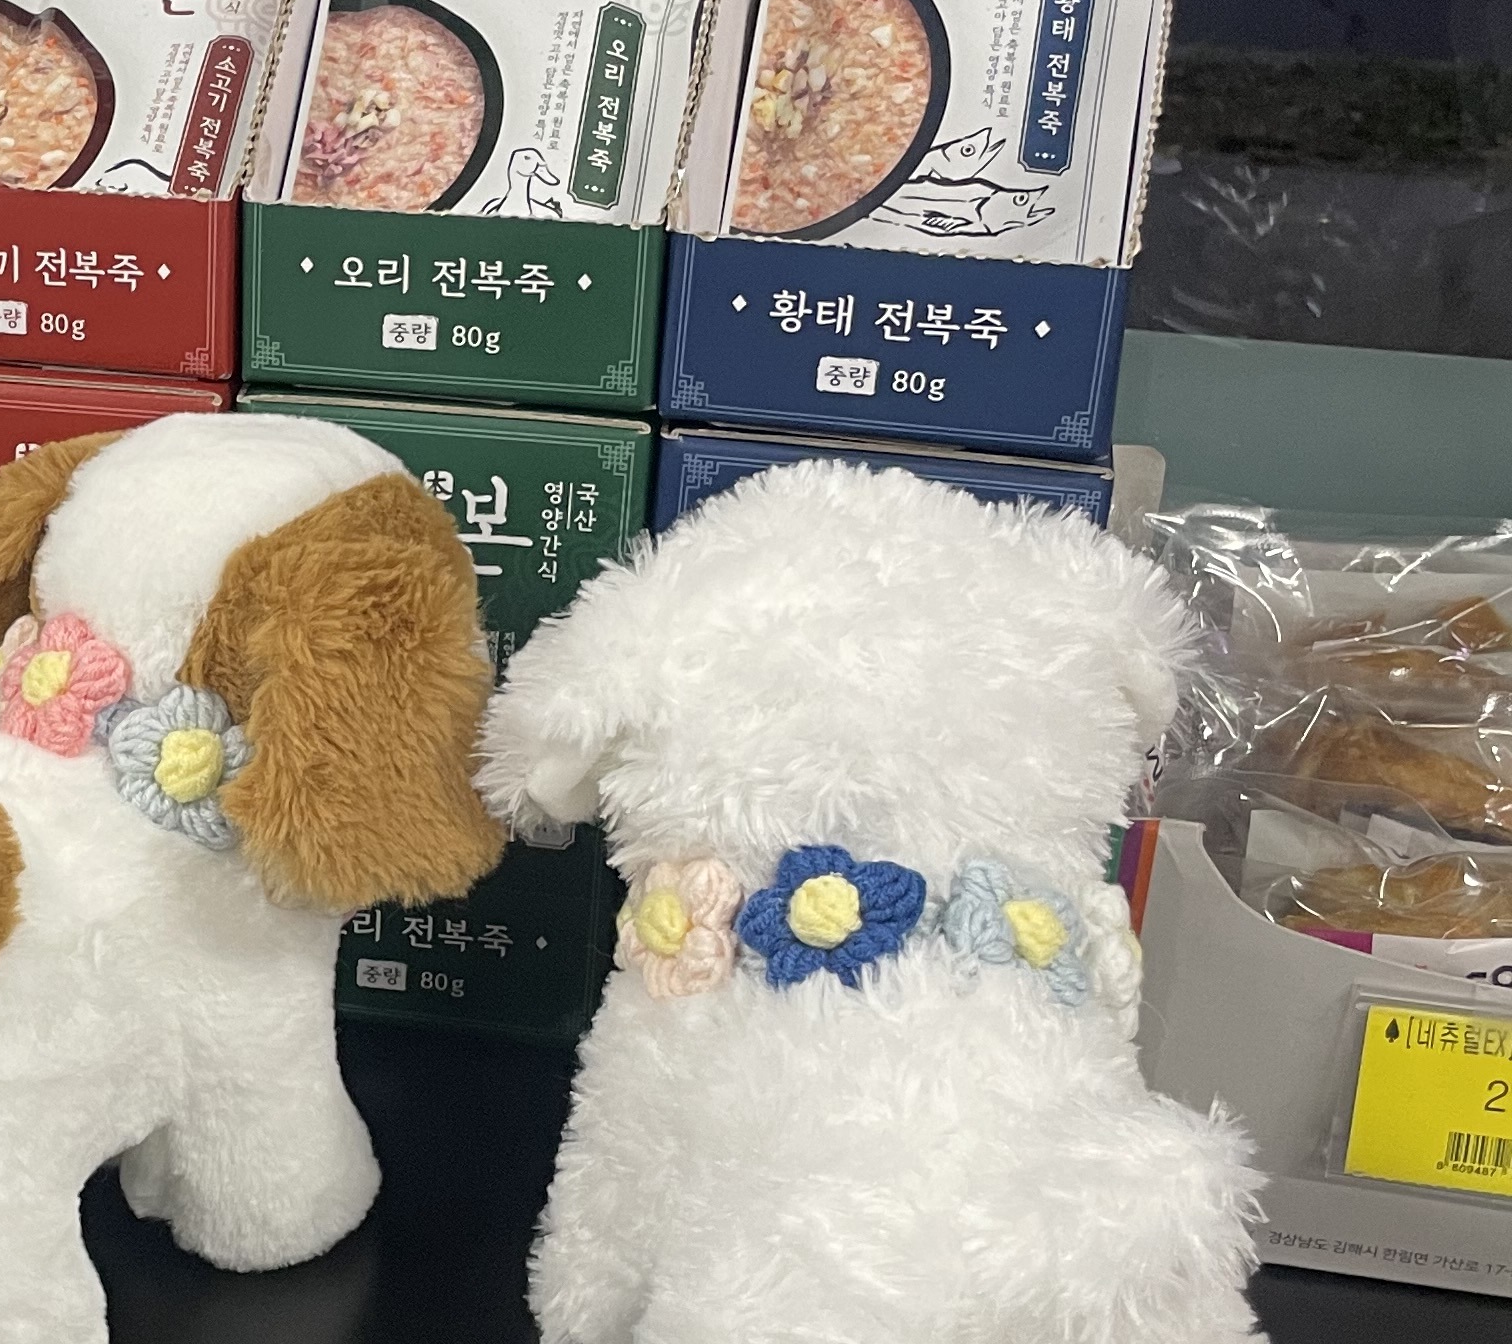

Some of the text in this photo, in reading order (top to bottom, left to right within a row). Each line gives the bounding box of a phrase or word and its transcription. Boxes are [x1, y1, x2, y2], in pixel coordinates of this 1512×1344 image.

[187, 54, 238, 184] 소고기 전복죽
[587, 39, 629, 174] 오리 전복죽
[1037, 52, 1071, 136] 전복죽
[35, 247, 144, 293] 전복죽
[334, 253, 555, 303] 오리 전복죽
[40, 312, 86, 341] 80g
[389, 322, 501, 354] 중량 80g
[769, 289, 1009, 350] 황태 전복죽
[824, 364, 947, 402] 중량 80g
[537, 481, 564, 584] 영양간식
[573, 483, 600, 533] 국산
[401, 914, 514, 957] 전복죽
[1405, 1016, 1512, 1061] [네츄럴EX
